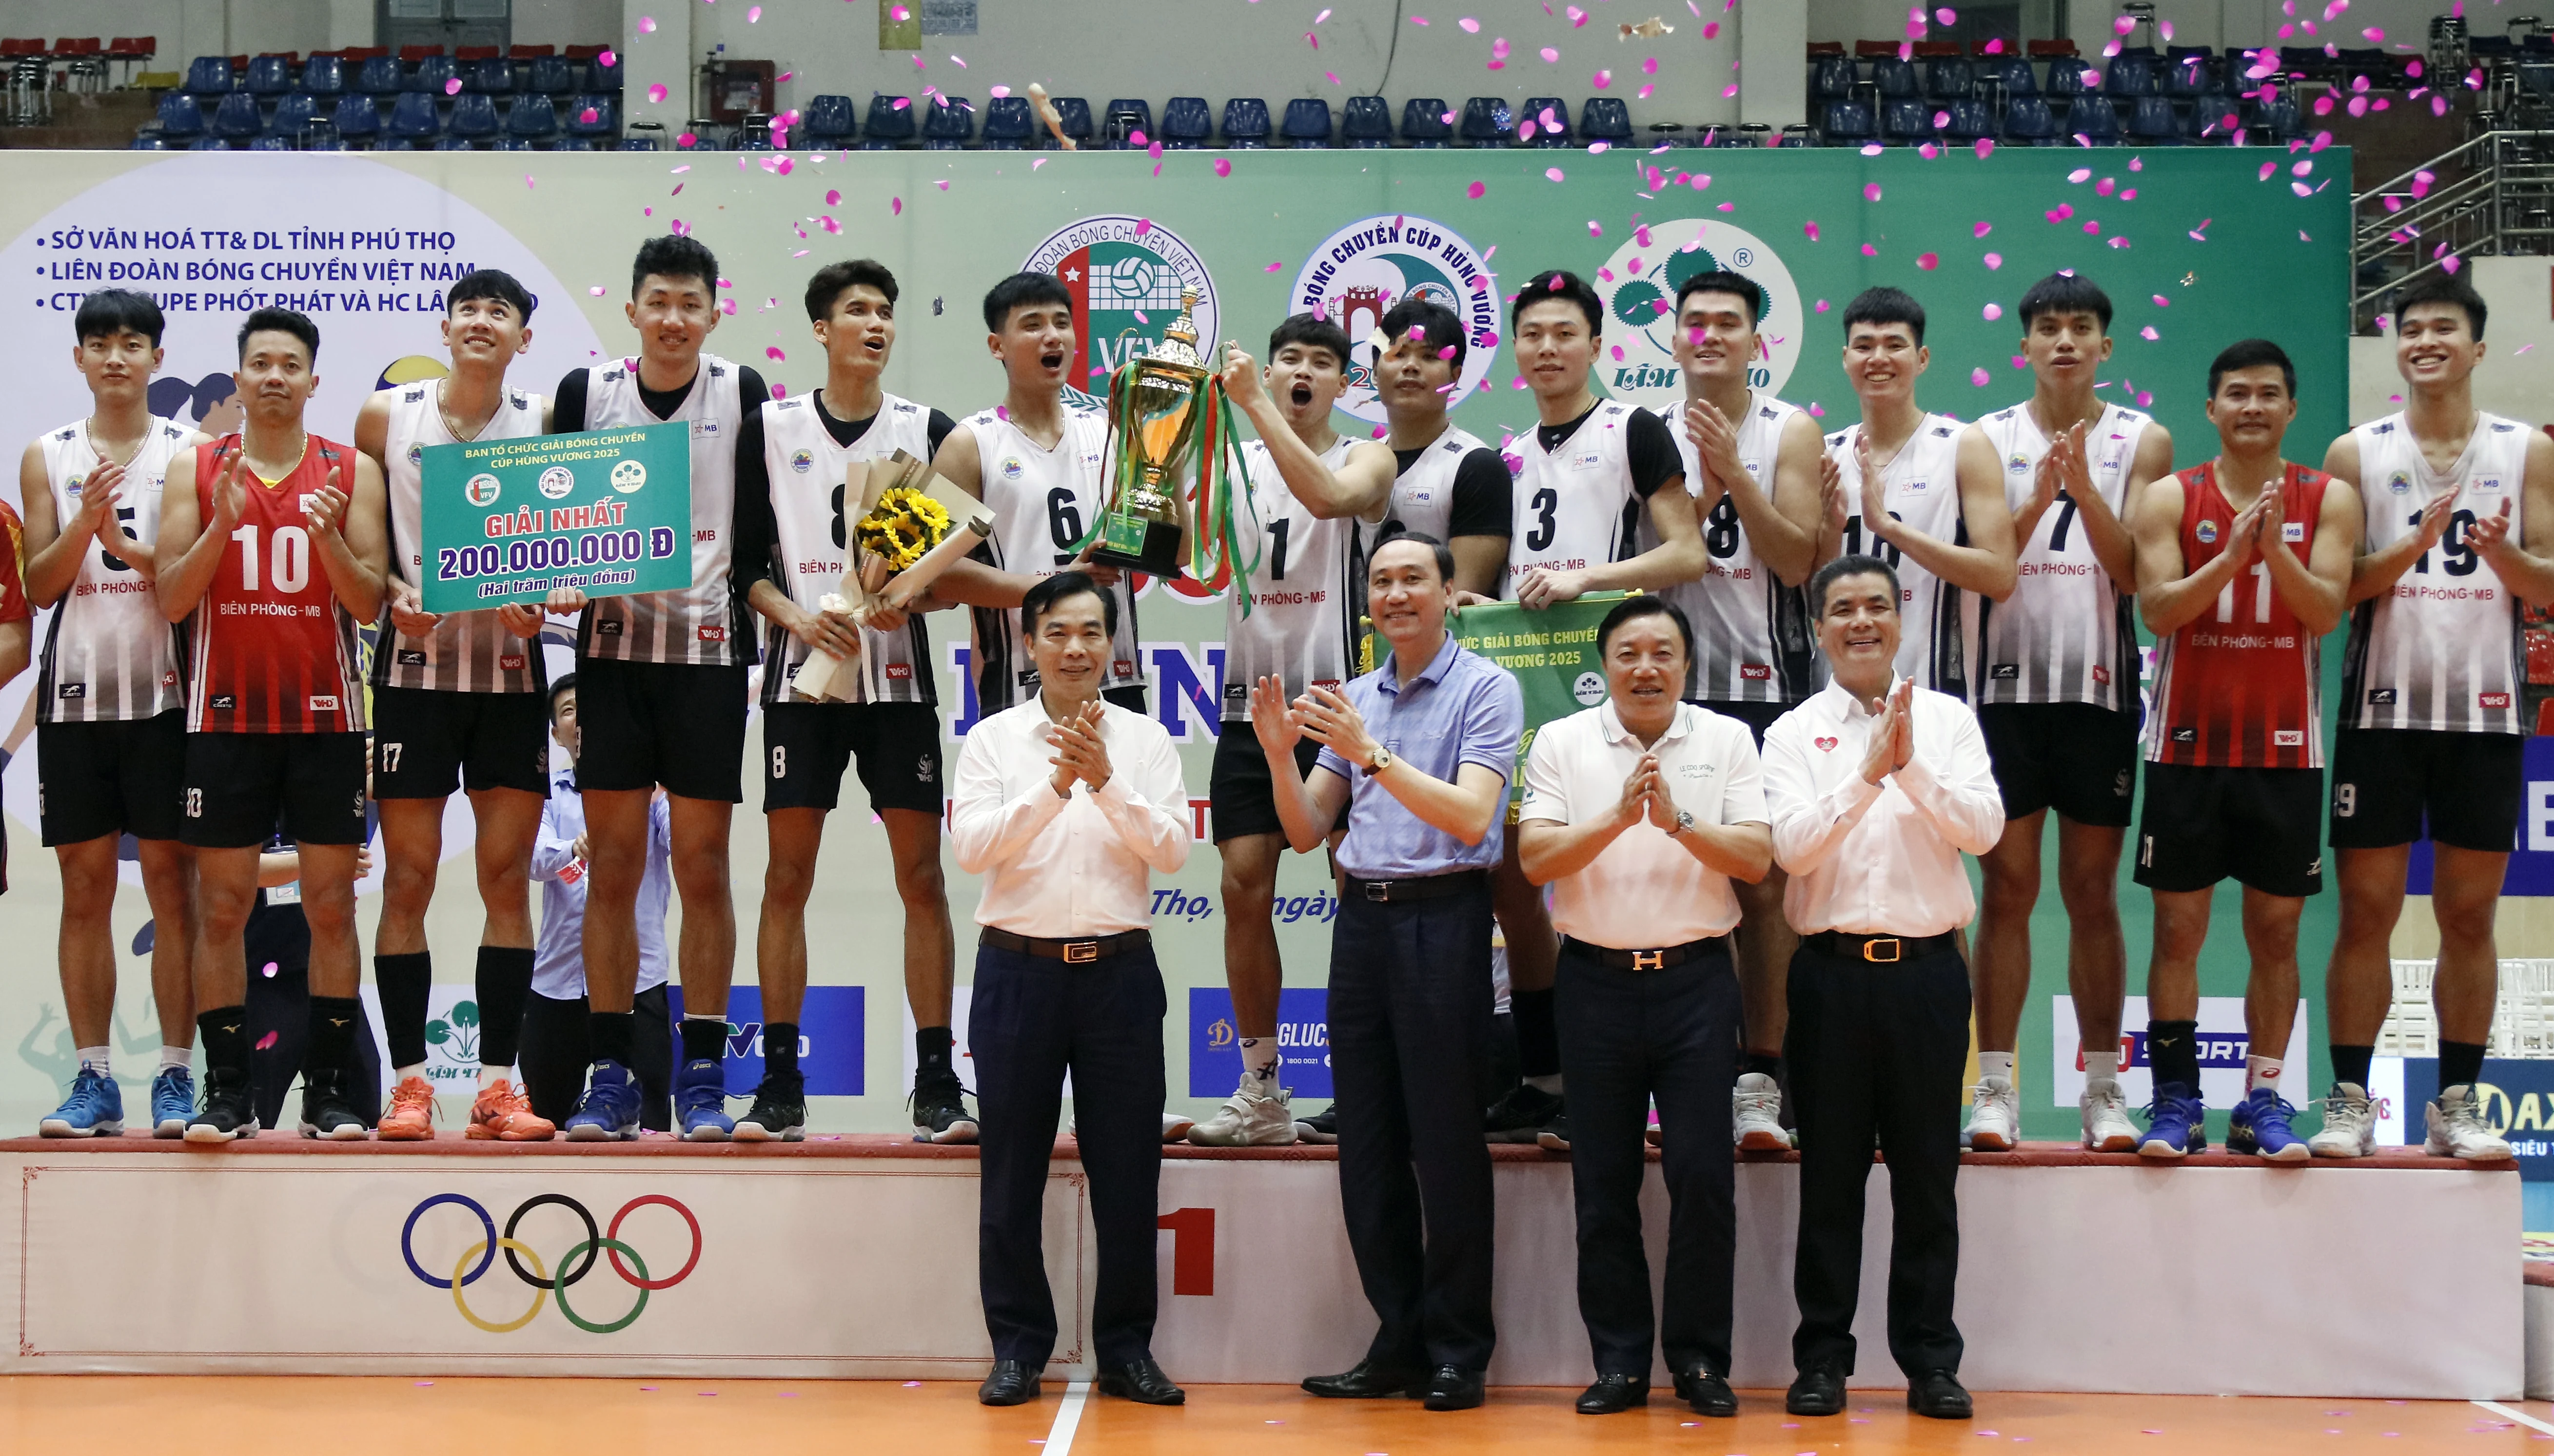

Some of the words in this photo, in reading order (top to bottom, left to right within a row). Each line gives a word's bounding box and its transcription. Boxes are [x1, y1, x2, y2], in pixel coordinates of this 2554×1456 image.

[52, 225, 84, 250] SỞ
[89, 227, 137, 250] VĂN
[144, 227, 196, 250] HOÁ
[201, 231, 247, 250] TT&
[254, 231, 283, 250] DL
[289, 226, 342, 250] TỈNH
[352, 228, 400, 250] PHÚ
[406, 231, 455, 255] THỌ
[1035, 239, 1070, 274] ĐOÀN
[1069, 227, 1109, 249] BÓNG
[1114, 225, 1170, 255] CHUYỀN
[1167, 247, 1194, 280] VIỆT
[52, 258, 102, 280] LIÊN
[108, 258, 178, 280] ĐOÀN
[186, 258, 254, 280] BÓNG
[261, 257, 356, 281] CHUYỀN
[363, 259, 414, 286] VIỆT
[421, 262, 476, 281] NAM
[1303, 260, 1336, 306] BÓNG
[1332, 221, 1399, 264] CHUYỀN
[1406, 227, 1441, 251] CÚP
[1441, 243, 1475, 288] HÙNG
[1470, 290, 1495, 349] VƯƠNG
[154, 293, 197, 311] UPE
[205, 287, 268, 311] PHỐT
[275, 290, 335, 312] PHÁT
[340, 290, 371, 312] VÀ
[378, 293, 409, 312] HC
[417, 290, 449, 312] LÂ
[705, 424, 718, 433] MB
[465, 447, 489, 459] BAN
[490, 442, 505, 457] TỔ
[506, 439, 539, 455] CHỨC
[541, 436, 565, 451] GIẢI
[566, 436, 592, 450] BÓNG
[594, 431, 646, 448] CHUYỀN
[491, 456, 514, 469] CÚP
[516, 453, 548, 466] HÙNG
[550, 450, 592, 464] VƯƠNG
[593, 448, 620, 459] 2025
[1585, 455, 1598, 464] MB
[2103, 461, 2118, 470] MB
[1416, 492, 1430, 501] MB
[1912, 482, 1926, 490] MB
[2483, 479, 2499, 489] MB
[485, 504, 544, 539] GIẢI
[551, 496, 628, 532] NHẤT
[1047, 487, 1085, 551] 6
[1526, 488, 1557, 551] 3
[2048, 489, 2077, 552] 7
[2286, 528, 2301, 537] MB
[2409, 509, 2478, 577] 19
[232, 524, 310, 593] 10
[439, 529, 643, 580] 200.000.000
[649, 525, 676, 560] Đ
[1265, 518, 1290, 580] 1
[799, 559, 828, 574] BIÊN
[2018, 561, 2039, 576] IÊN
[77, 582, 97, 596] BIÊN
[101, 579, 156, 594] PHÒNG-
[477, 580, 509, 599] (Hai
[513, 577, 548, 593] trăm
[552, 573, 587, 592] triệu
[592, 568, 636, 587] đồng)
[1237, 594, 1257, 605] BN
[1261, 590, 1326, 605] PHÒNG-MB
[2217, 559, 2271, 624] 11
[2389, 584, 2416, 598] BIÊN
[2420, 584, 2495, 601] PHÒNG-MB
[220, 600, 247, 616] BIÊN
[1483, 632, 1511, 649] GIẢI
[1514, 632, 1550, 647] BÓNG
[2191, 634, 2219, 647] BIÊN
[2221, 632, 2296, 649] PHÒNG-MB
[1496, 653, 1545, 668] VƯƠNG
[1549, 651, 1581, 665] 2025
[382, 743, 402, 773] 17
[772, 745, 787, 778] 8
[186, 788, 203, 818] 10
[2334, 783, 2357, 817] 19
[1157, 1207, 1215, 1296] 1
